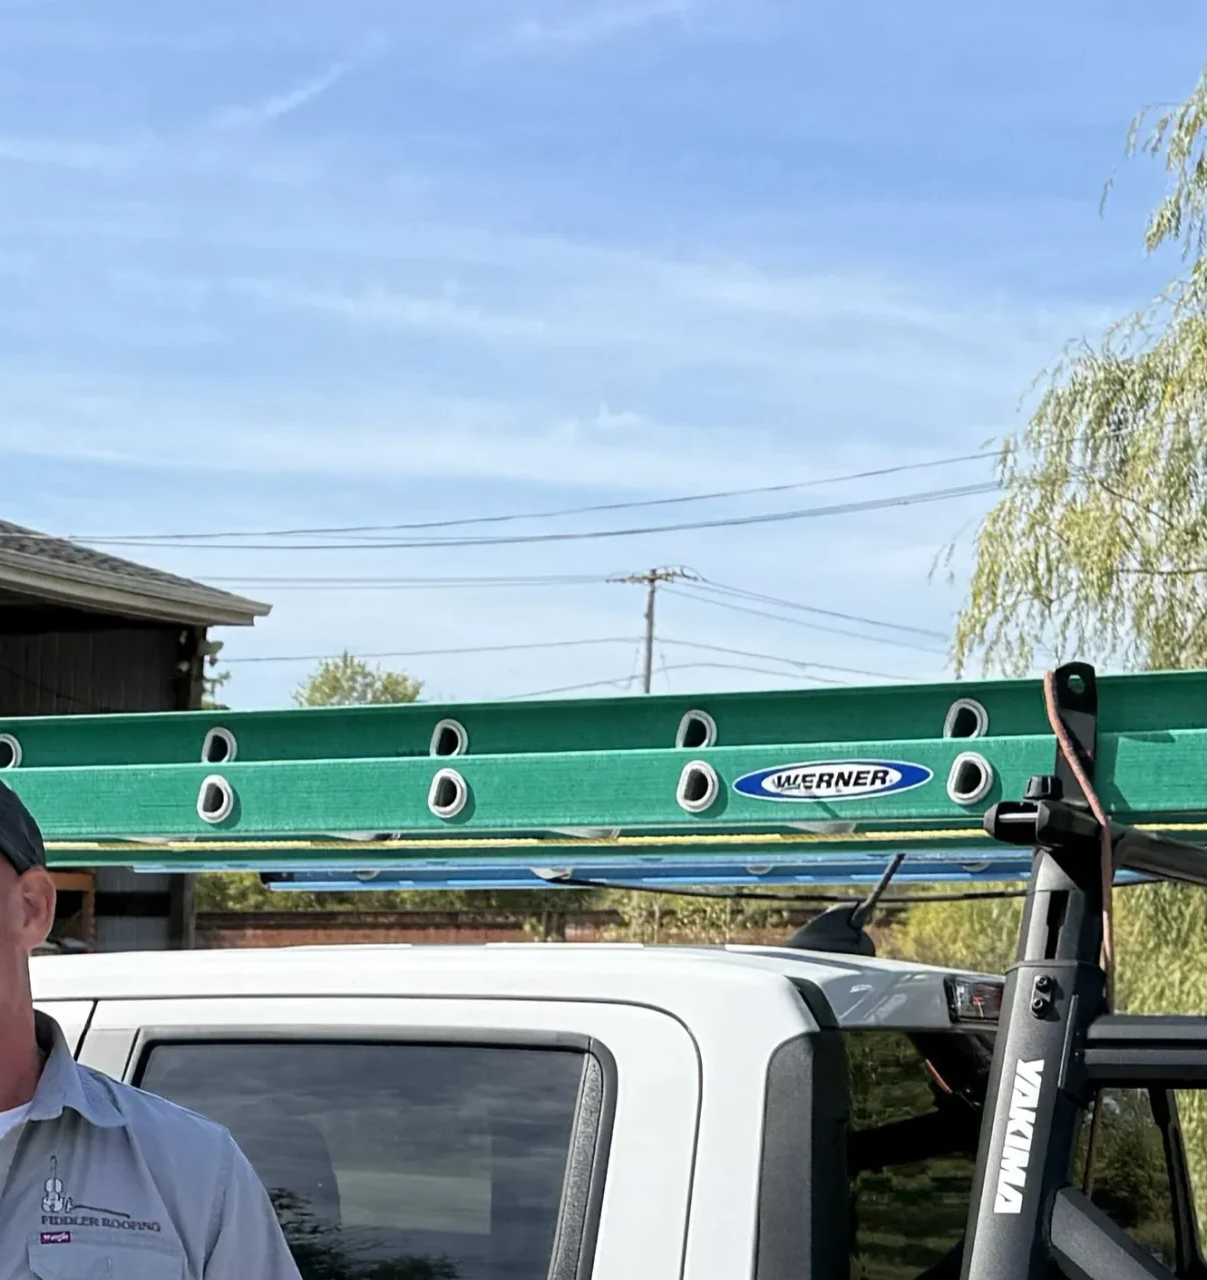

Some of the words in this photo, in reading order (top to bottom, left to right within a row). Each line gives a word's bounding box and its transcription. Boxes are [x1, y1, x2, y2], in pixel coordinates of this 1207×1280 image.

[775, 769, 890, 791] WERNER
[994, 1058, 1045, 1214] YAKIMA
[41, 1215, 100, 1227] FIDDLER
[101, 1217, 161, 1232] ROOFING
